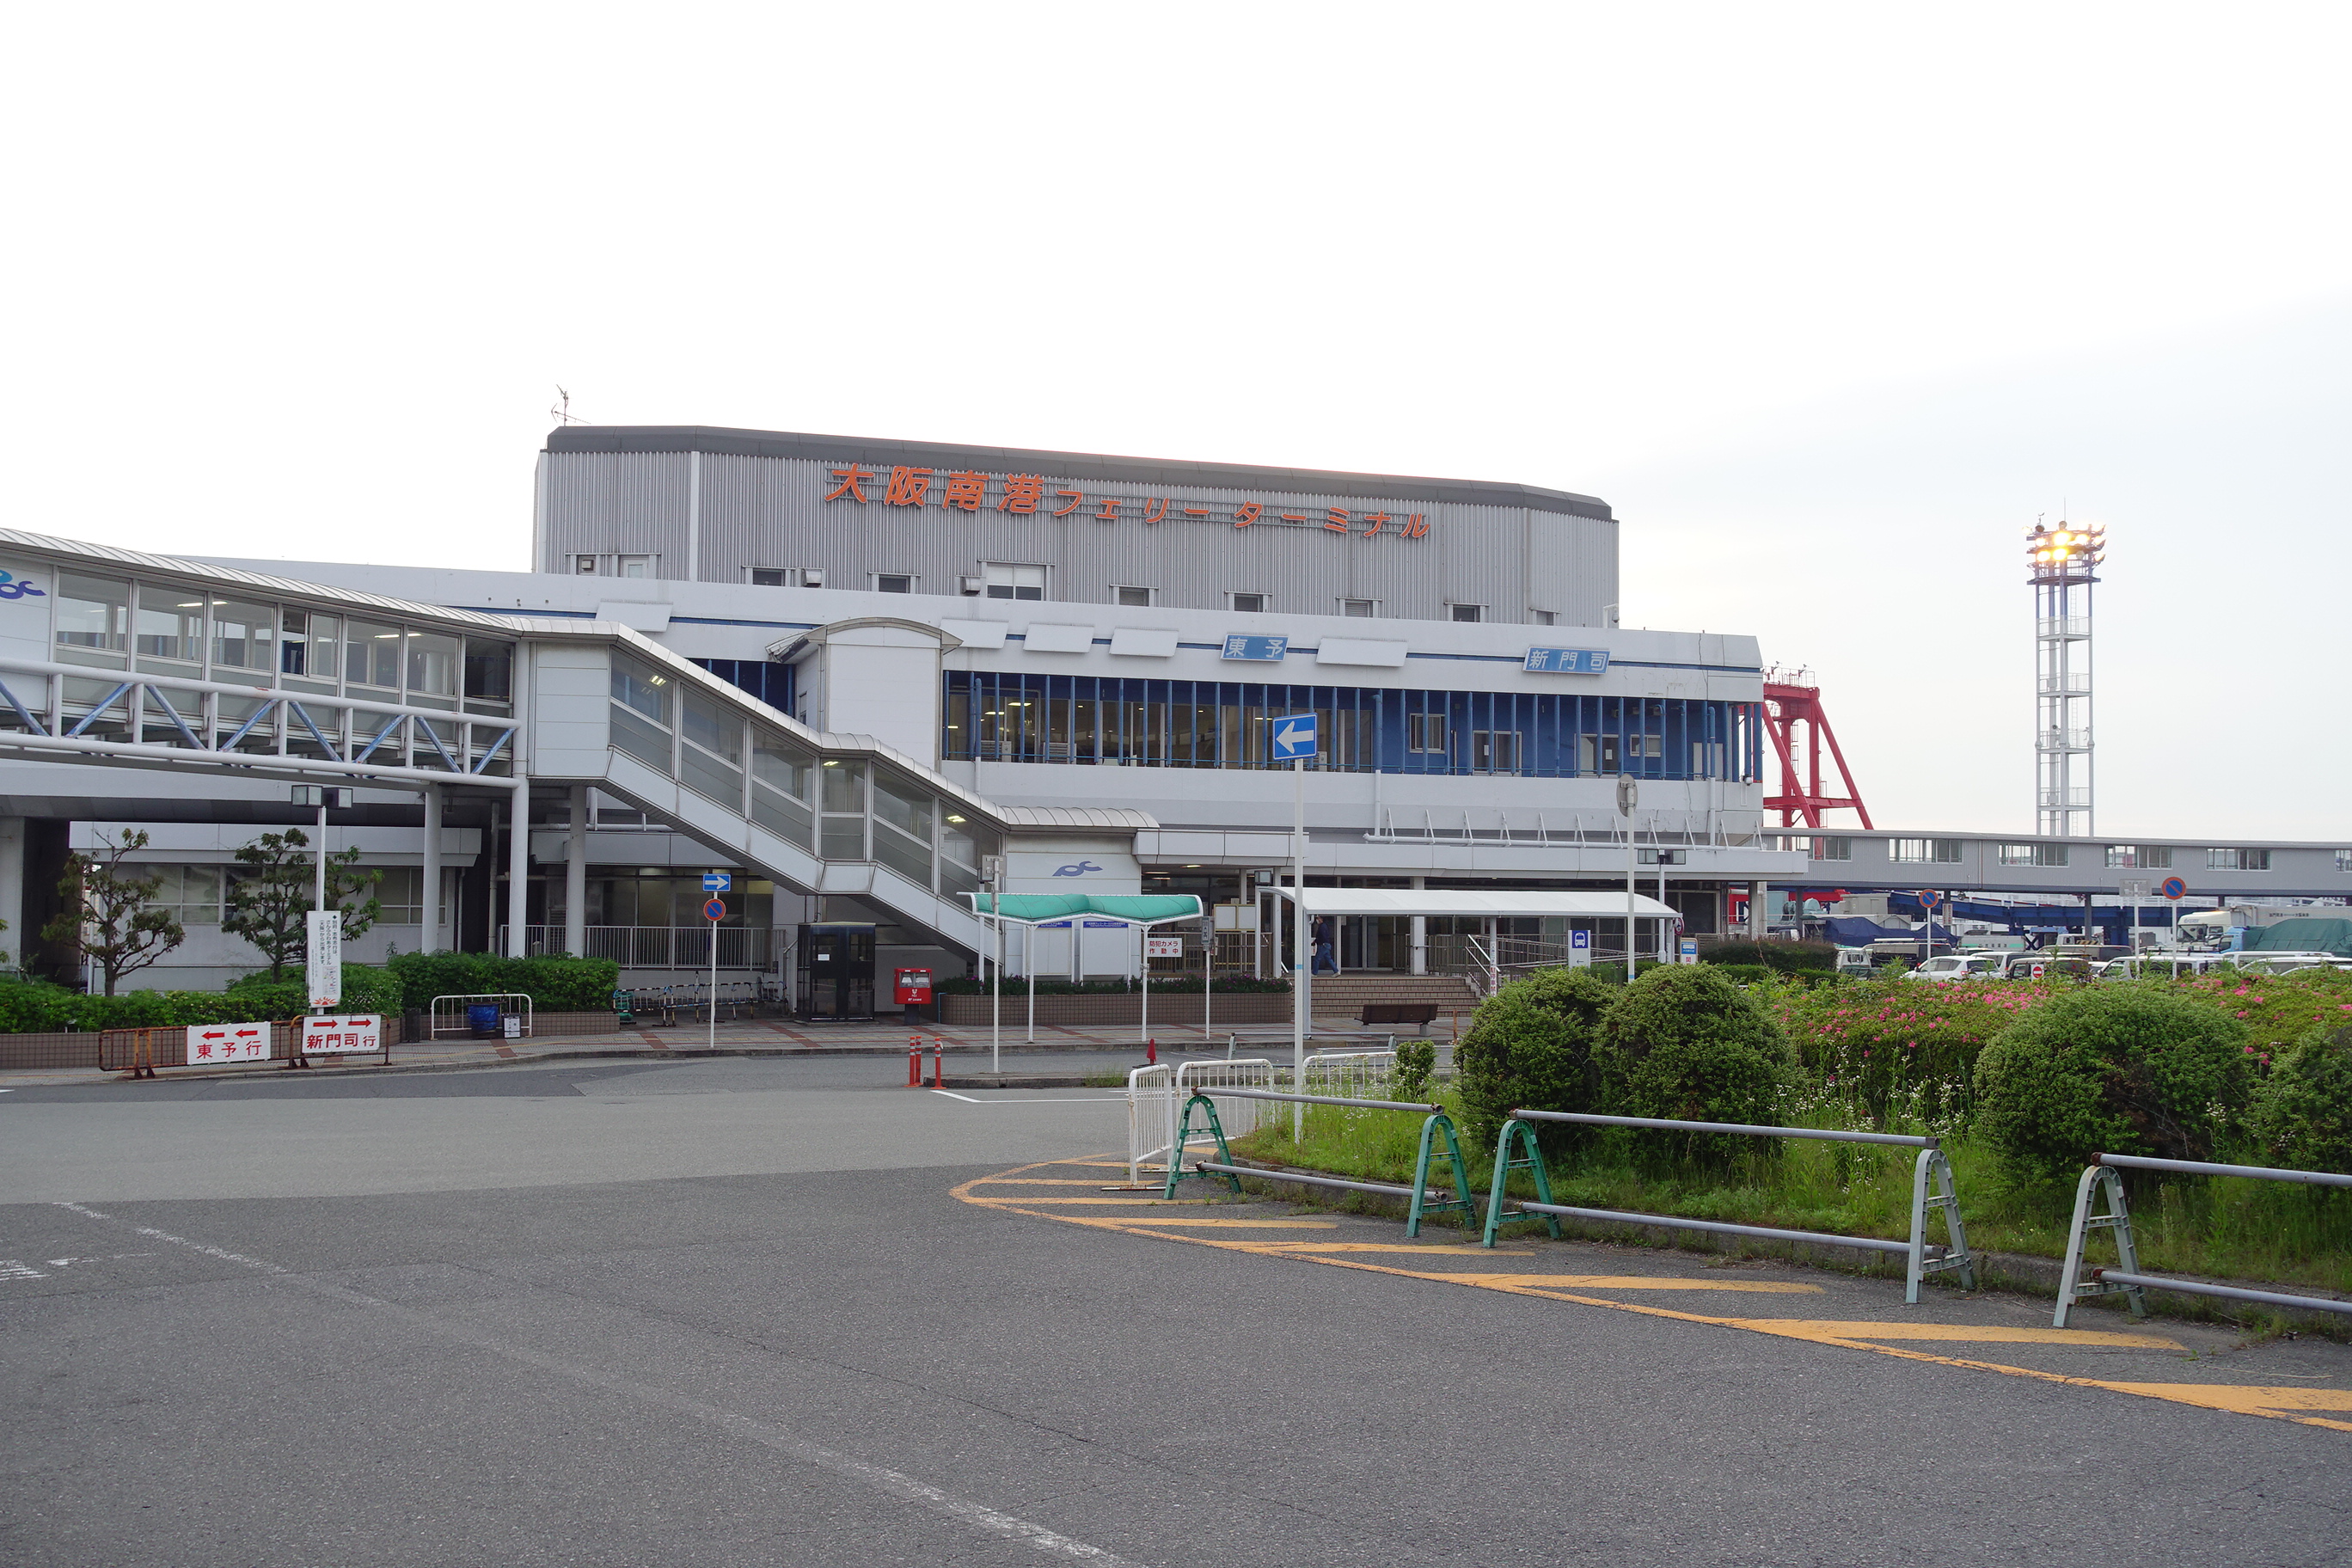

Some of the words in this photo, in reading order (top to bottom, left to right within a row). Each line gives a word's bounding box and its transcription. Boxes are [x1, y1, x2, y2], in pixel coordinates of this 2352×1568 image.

[824, 462, 1430, 538] 大阪南港フェリーターミナル
[1225, 637, 1283, 658] 東予
[1528, 650, 1608, 671] 新門司
[196, 1040, 262, 1059] 東予行
[306, 1032, 377, 1049] 新門司行
